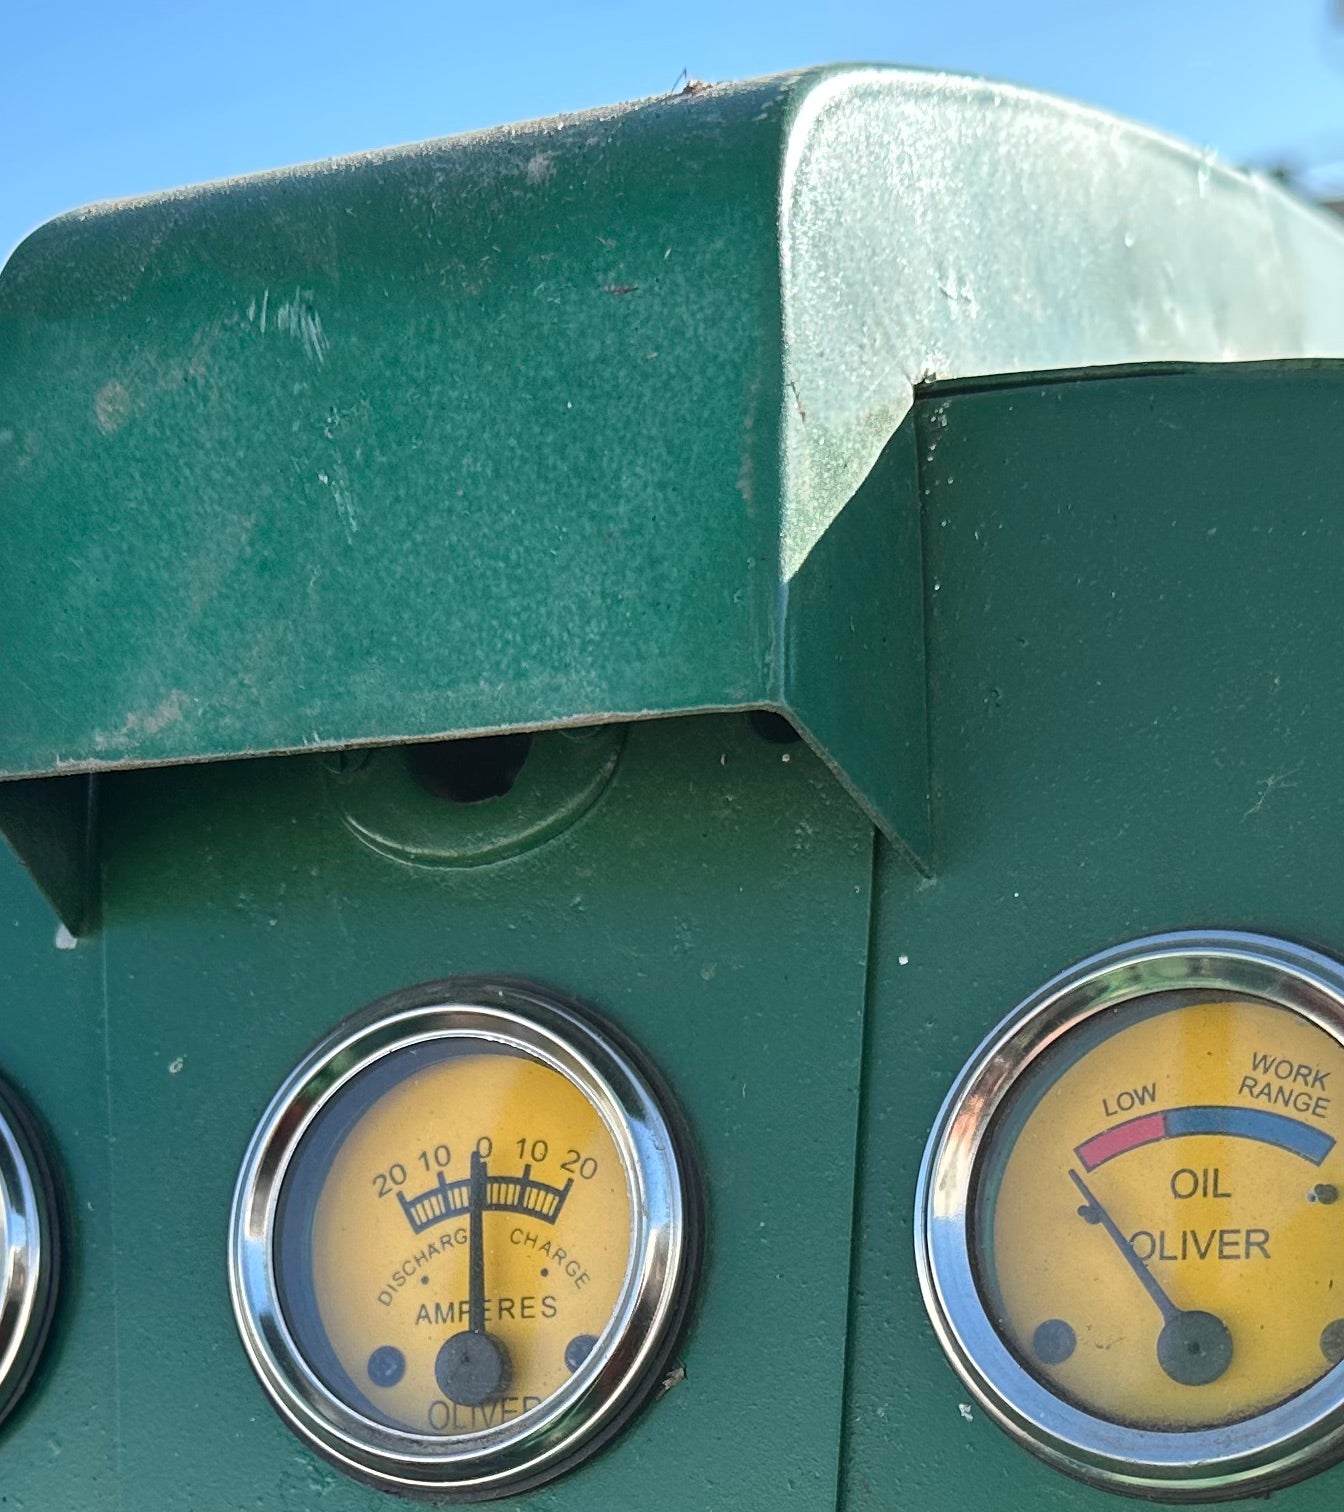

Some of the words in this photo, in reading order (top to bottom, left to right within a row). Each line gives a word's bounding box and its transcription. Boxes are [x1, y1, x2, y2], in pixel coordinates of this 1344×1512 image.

[1251, 1052, 1332, 1091] WORK
[1102, 1083, 1158, 1117] LOW
[1238, 1076, 1331, 1119] RANGE
[372, 1164, 406, 1198] 20
[418, 1145, 451, 1172] 10
[476, 1136, 493, 1159] 0
[516, 1138, 548, 1162] 10
[560, 1150, 598, 1180] 20
[1170, 1168, 1232, 1200] OIL
[1129, 1228, 1272, 1261] OLIVER
[377, 1228, 468, 1307] DISCHARG
[509, 1228, 591, 1290] CHARGE
